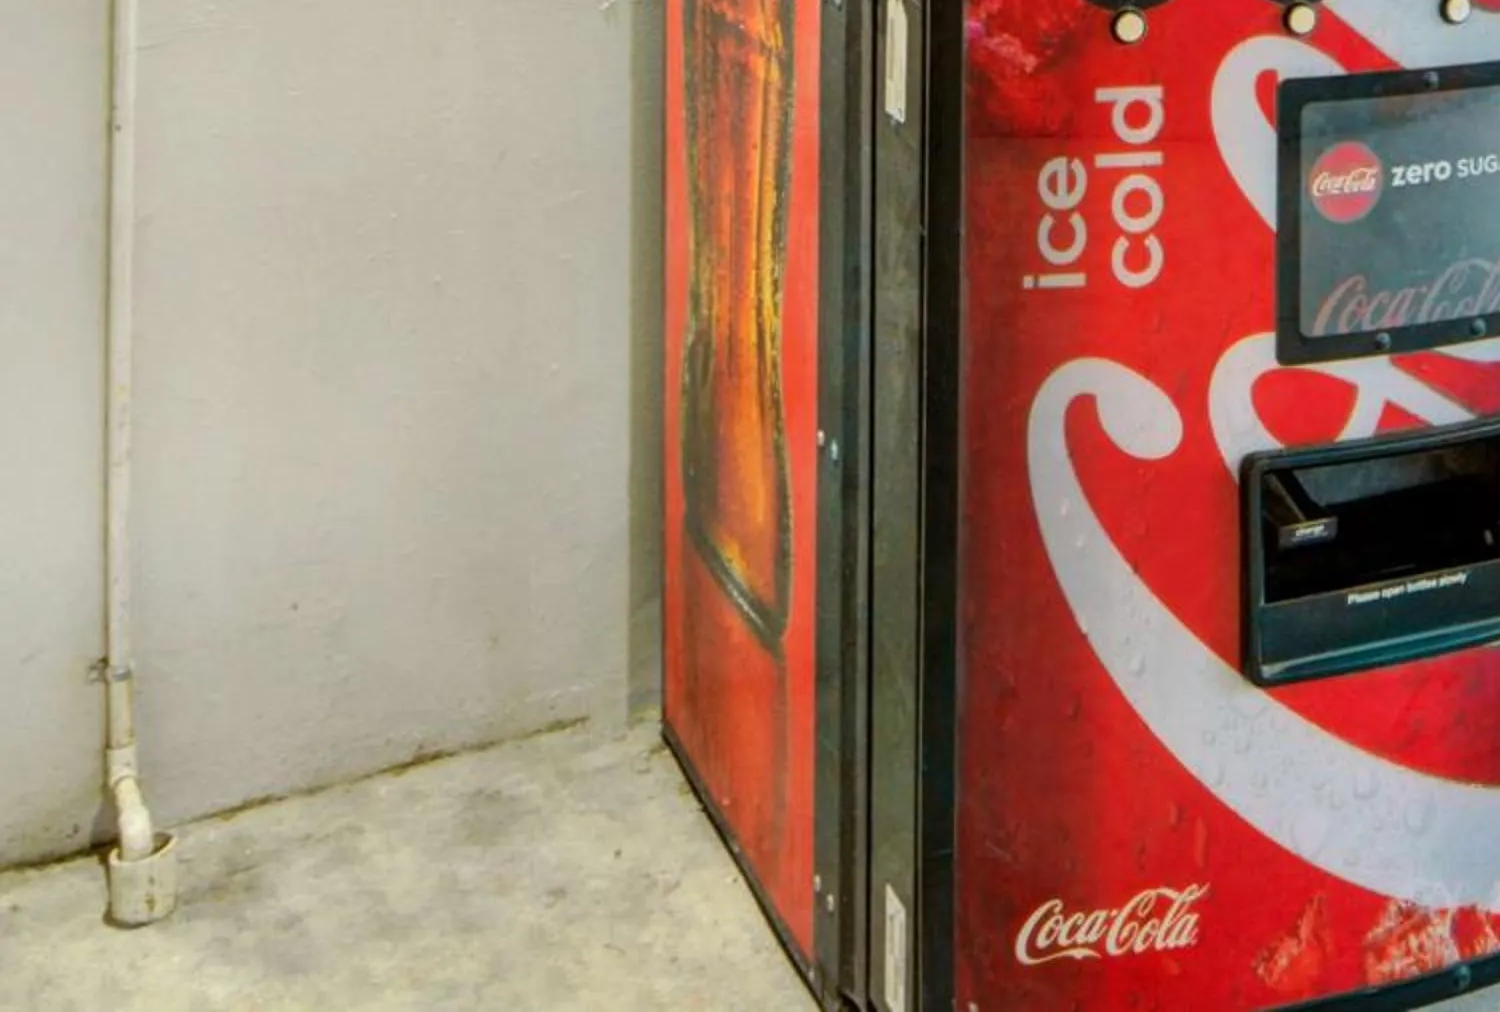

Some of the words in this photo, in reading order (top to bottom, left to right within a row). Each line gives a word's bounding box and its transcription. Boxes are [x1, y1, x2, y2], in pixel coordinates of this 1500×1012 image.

[1023, 156, 1087, 289] ice
[1094, 85, 1164, 288] cold
[1391, 159, 1452, 187] zero
[1015, 883, 1210, 965] Coca-Cola
